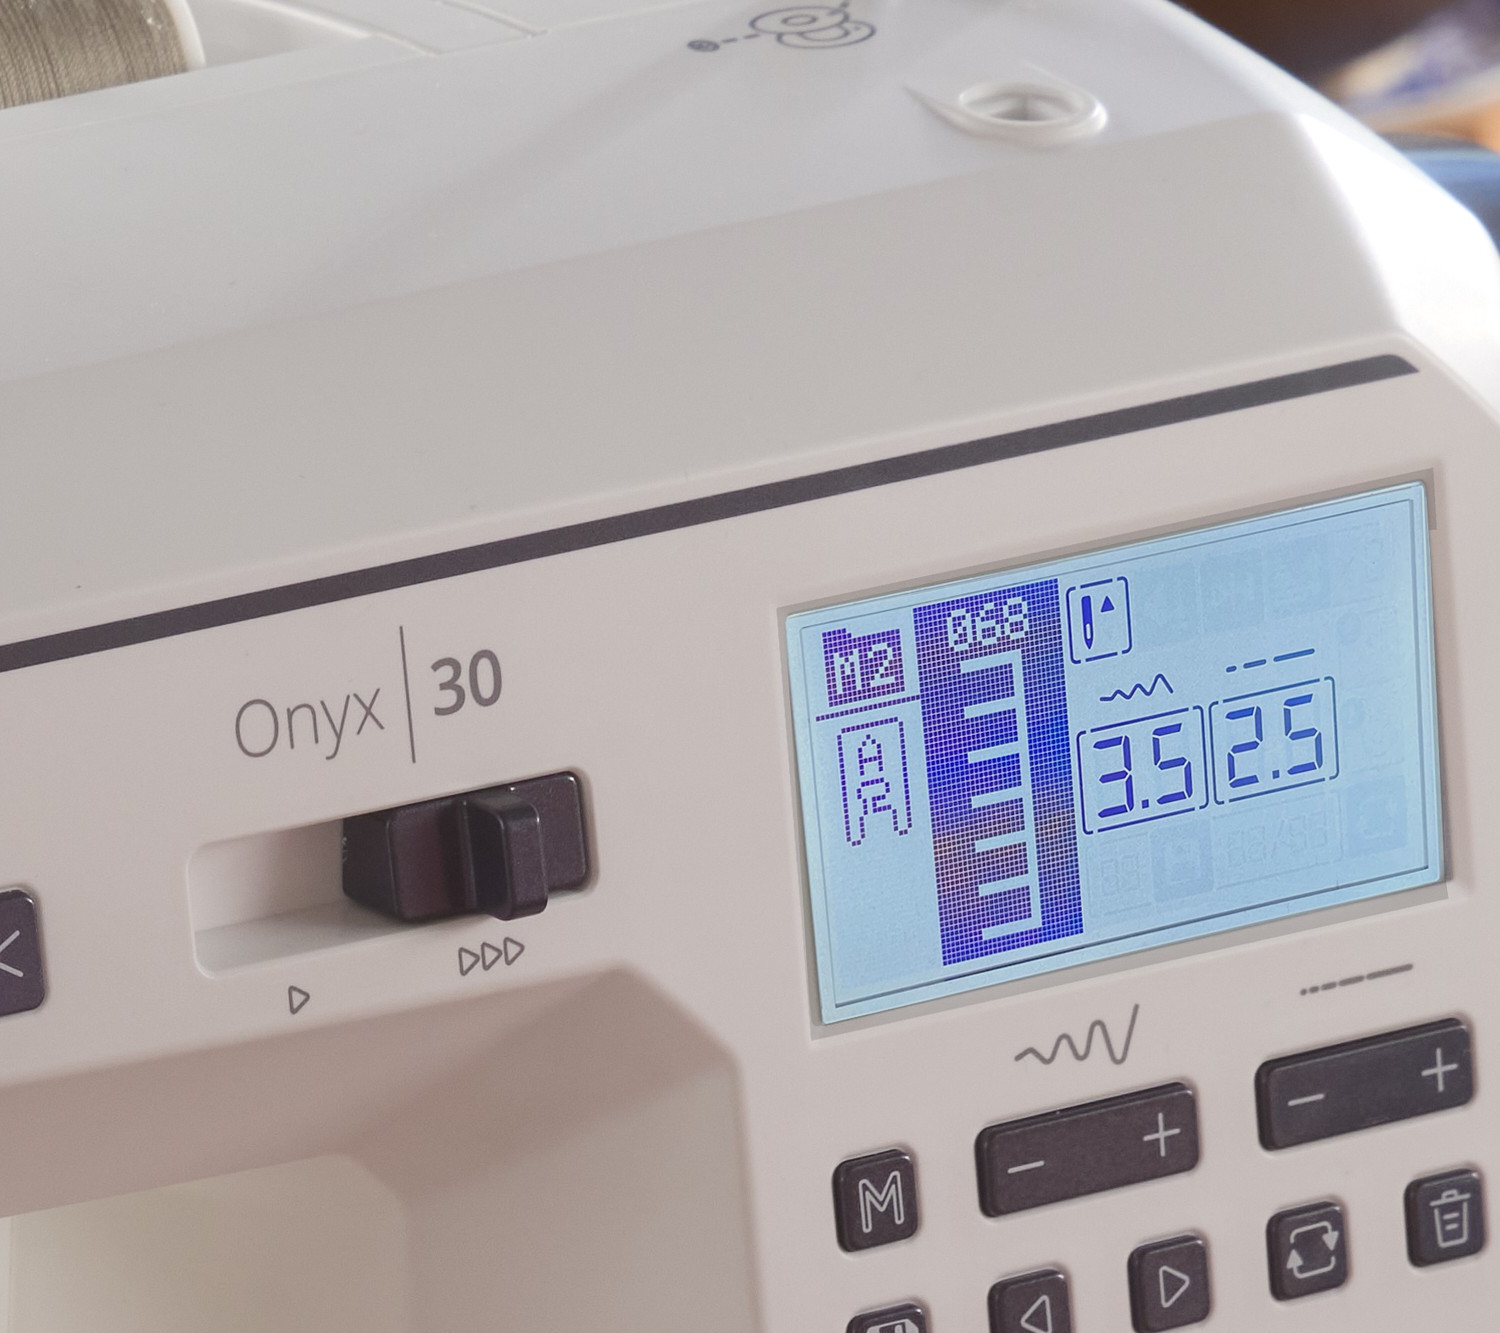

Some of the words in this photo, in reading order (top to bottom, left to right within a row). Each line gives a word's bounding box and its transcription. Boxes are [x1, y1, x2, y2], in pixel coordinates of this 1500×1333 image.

[947, 597, 1028, 652] 068
[834, 643, 898, 695] M2
[235, 688, 384, 760] Onyx
[431, 650, 502, 716] 30
[857, 733, 884, 776] A
[1092, 722, 1193, 818] 3.5
[1225, 693, 1323, 789] 2.5
[859, 1171, 904, 1233] M
